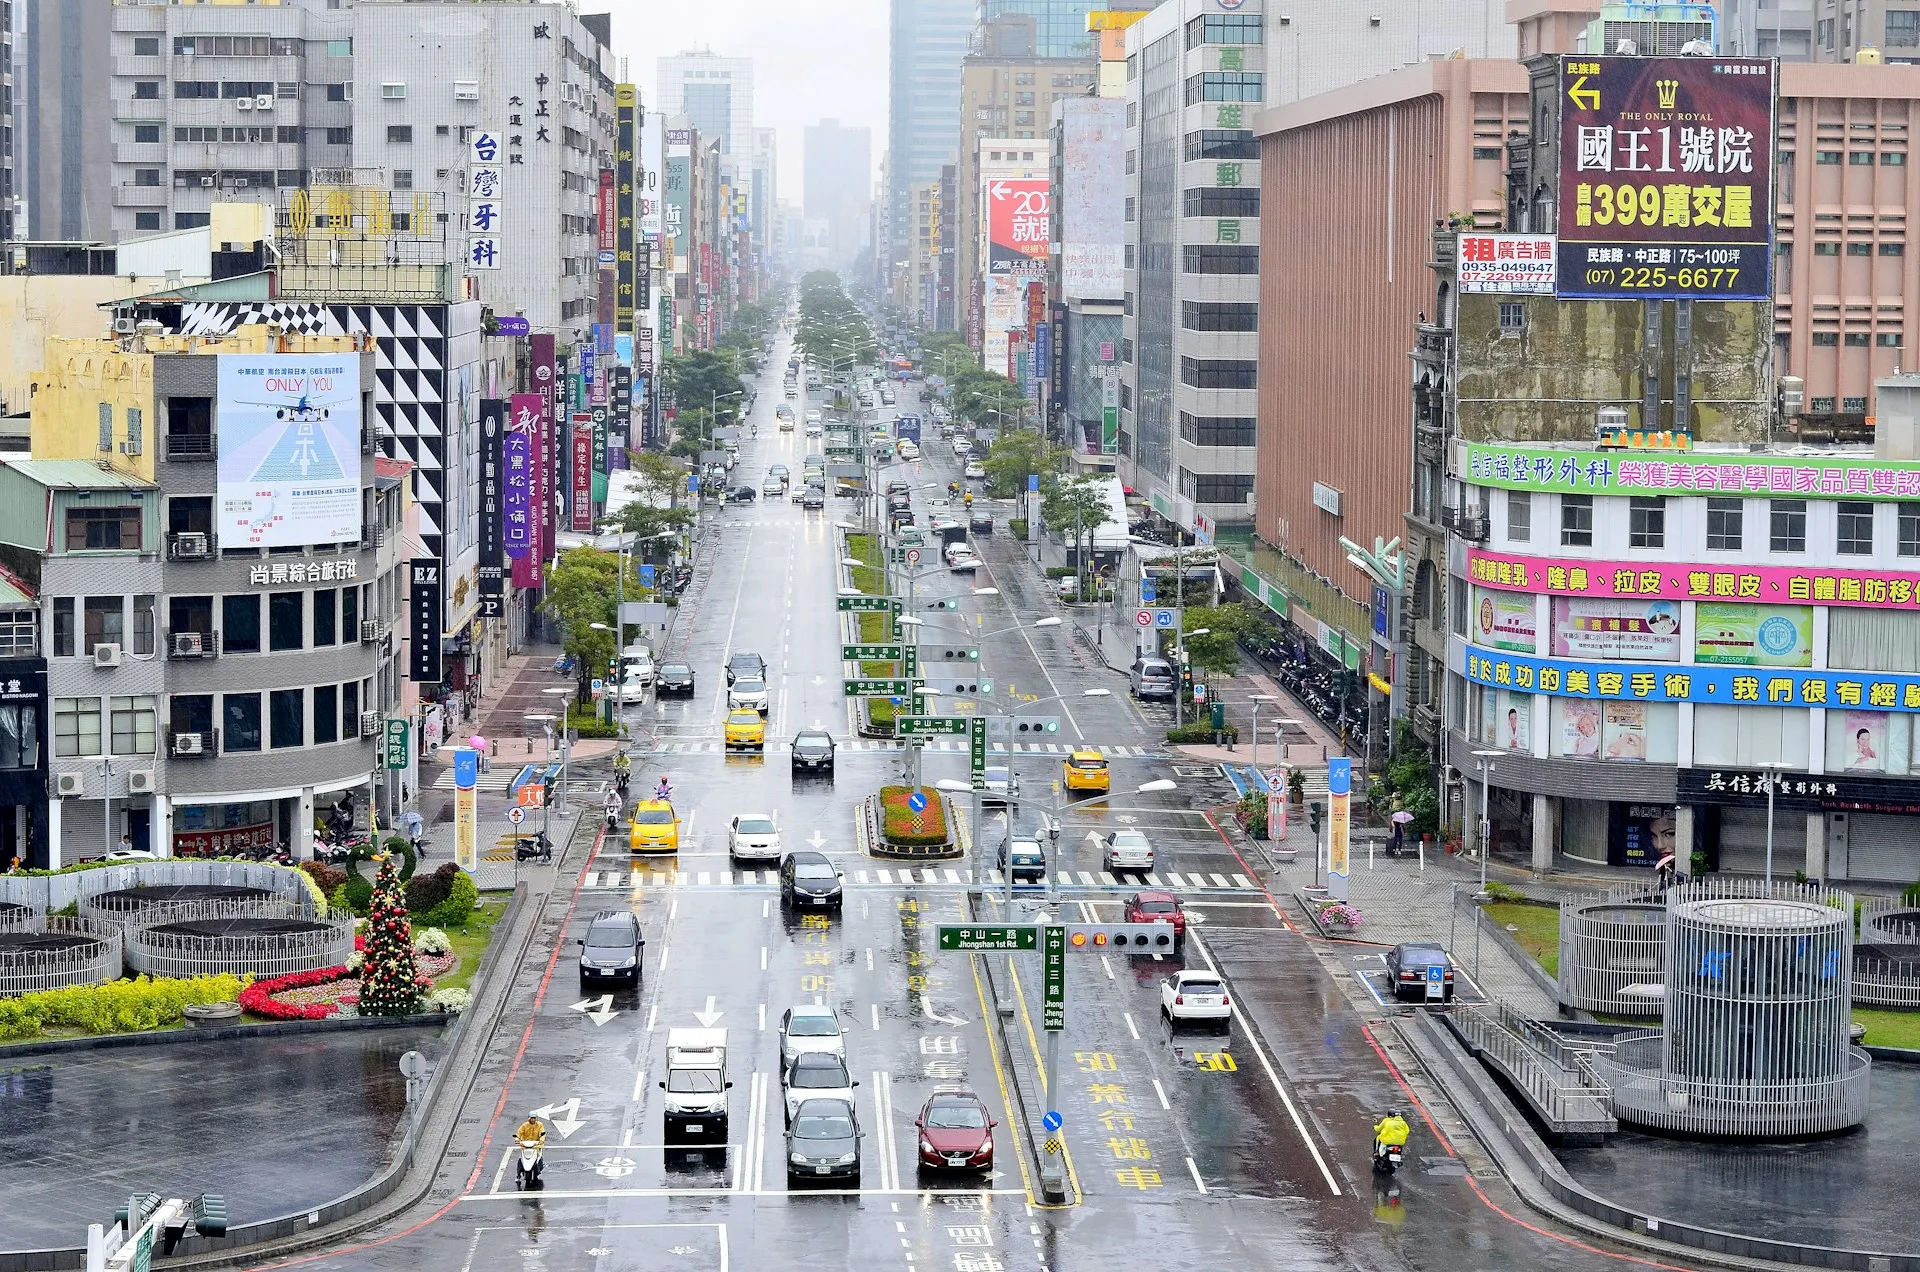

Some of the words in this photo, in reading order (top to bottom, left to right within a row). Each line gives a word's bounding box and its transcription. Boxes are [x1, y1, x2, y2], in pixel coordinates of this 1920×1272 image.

[1567, 63, 1600, 75] 民族路
[1620, 112, 1641, 121] THE
[1645, 112, 1674, 121] ONLY
[1678, 113, 1713, 121] ROYAL
[1216, 46, 1243, 244] 高雄郵局
[1577, 125, 1754, 174] 國王1號院
[472, 133, 499, 268] 台灣牙科
[1594, 184, 1752, 228] 399萬交屋
[1462, 237, 1496, 262] 租
[1498, 241, 1552, 260] 廣告牆
[1462, 262, 1553, 273] 0935-049647
[1461, 272, 1553, 281] 07-2269777
[1586, 269, 1615, 285] (07)
[1620, 267, 1740, 289] 225-6677
[265, 378, 304, 392] ONLY
[313, 377, 333, 391] YOU
[1471, 450, 1613, 487] 吳信福整形外科
[509, 438, 525, 539] 大黑松小倆口
[531, 537, 537, 545] YE
[249, 558, 357, 586] 尚景綜合旅行社
[414, 567, 437, 581] EZ
[484, 601, 498, 615] P
[912, 727, 937, 735] Jhongshan
[937, 726, 945, 734] 1st
[945, 726, 954, 734] Rd.
[913, 719, 953, 727] 中山一路
[974, 727, 983, 766] 中正三路
[1780, 780, 1838, 796] 整形外科
[960, 929, 1018, 940] 中山一路
[958, 940, 995, 949] Jhongshan
[996, 940, 1006, 949] 1st
[1006, 940, 1018, 949] Rd.
[1049, 939, 1060, 996] 中正三路
[1044, 1000, 1064, 1010] Jhong
[1044, 1010, 1064, 1019] Jheng
[1044, 1018, 1053, 1027] 3rd
[1054, 1018, 1064, 1027] Rd.
[1074, 1051, 1119, 1073] 50
[1193, 1051, 1238, 1073] 50
[1086, 1083, 1164, 1191] 禁行機車
